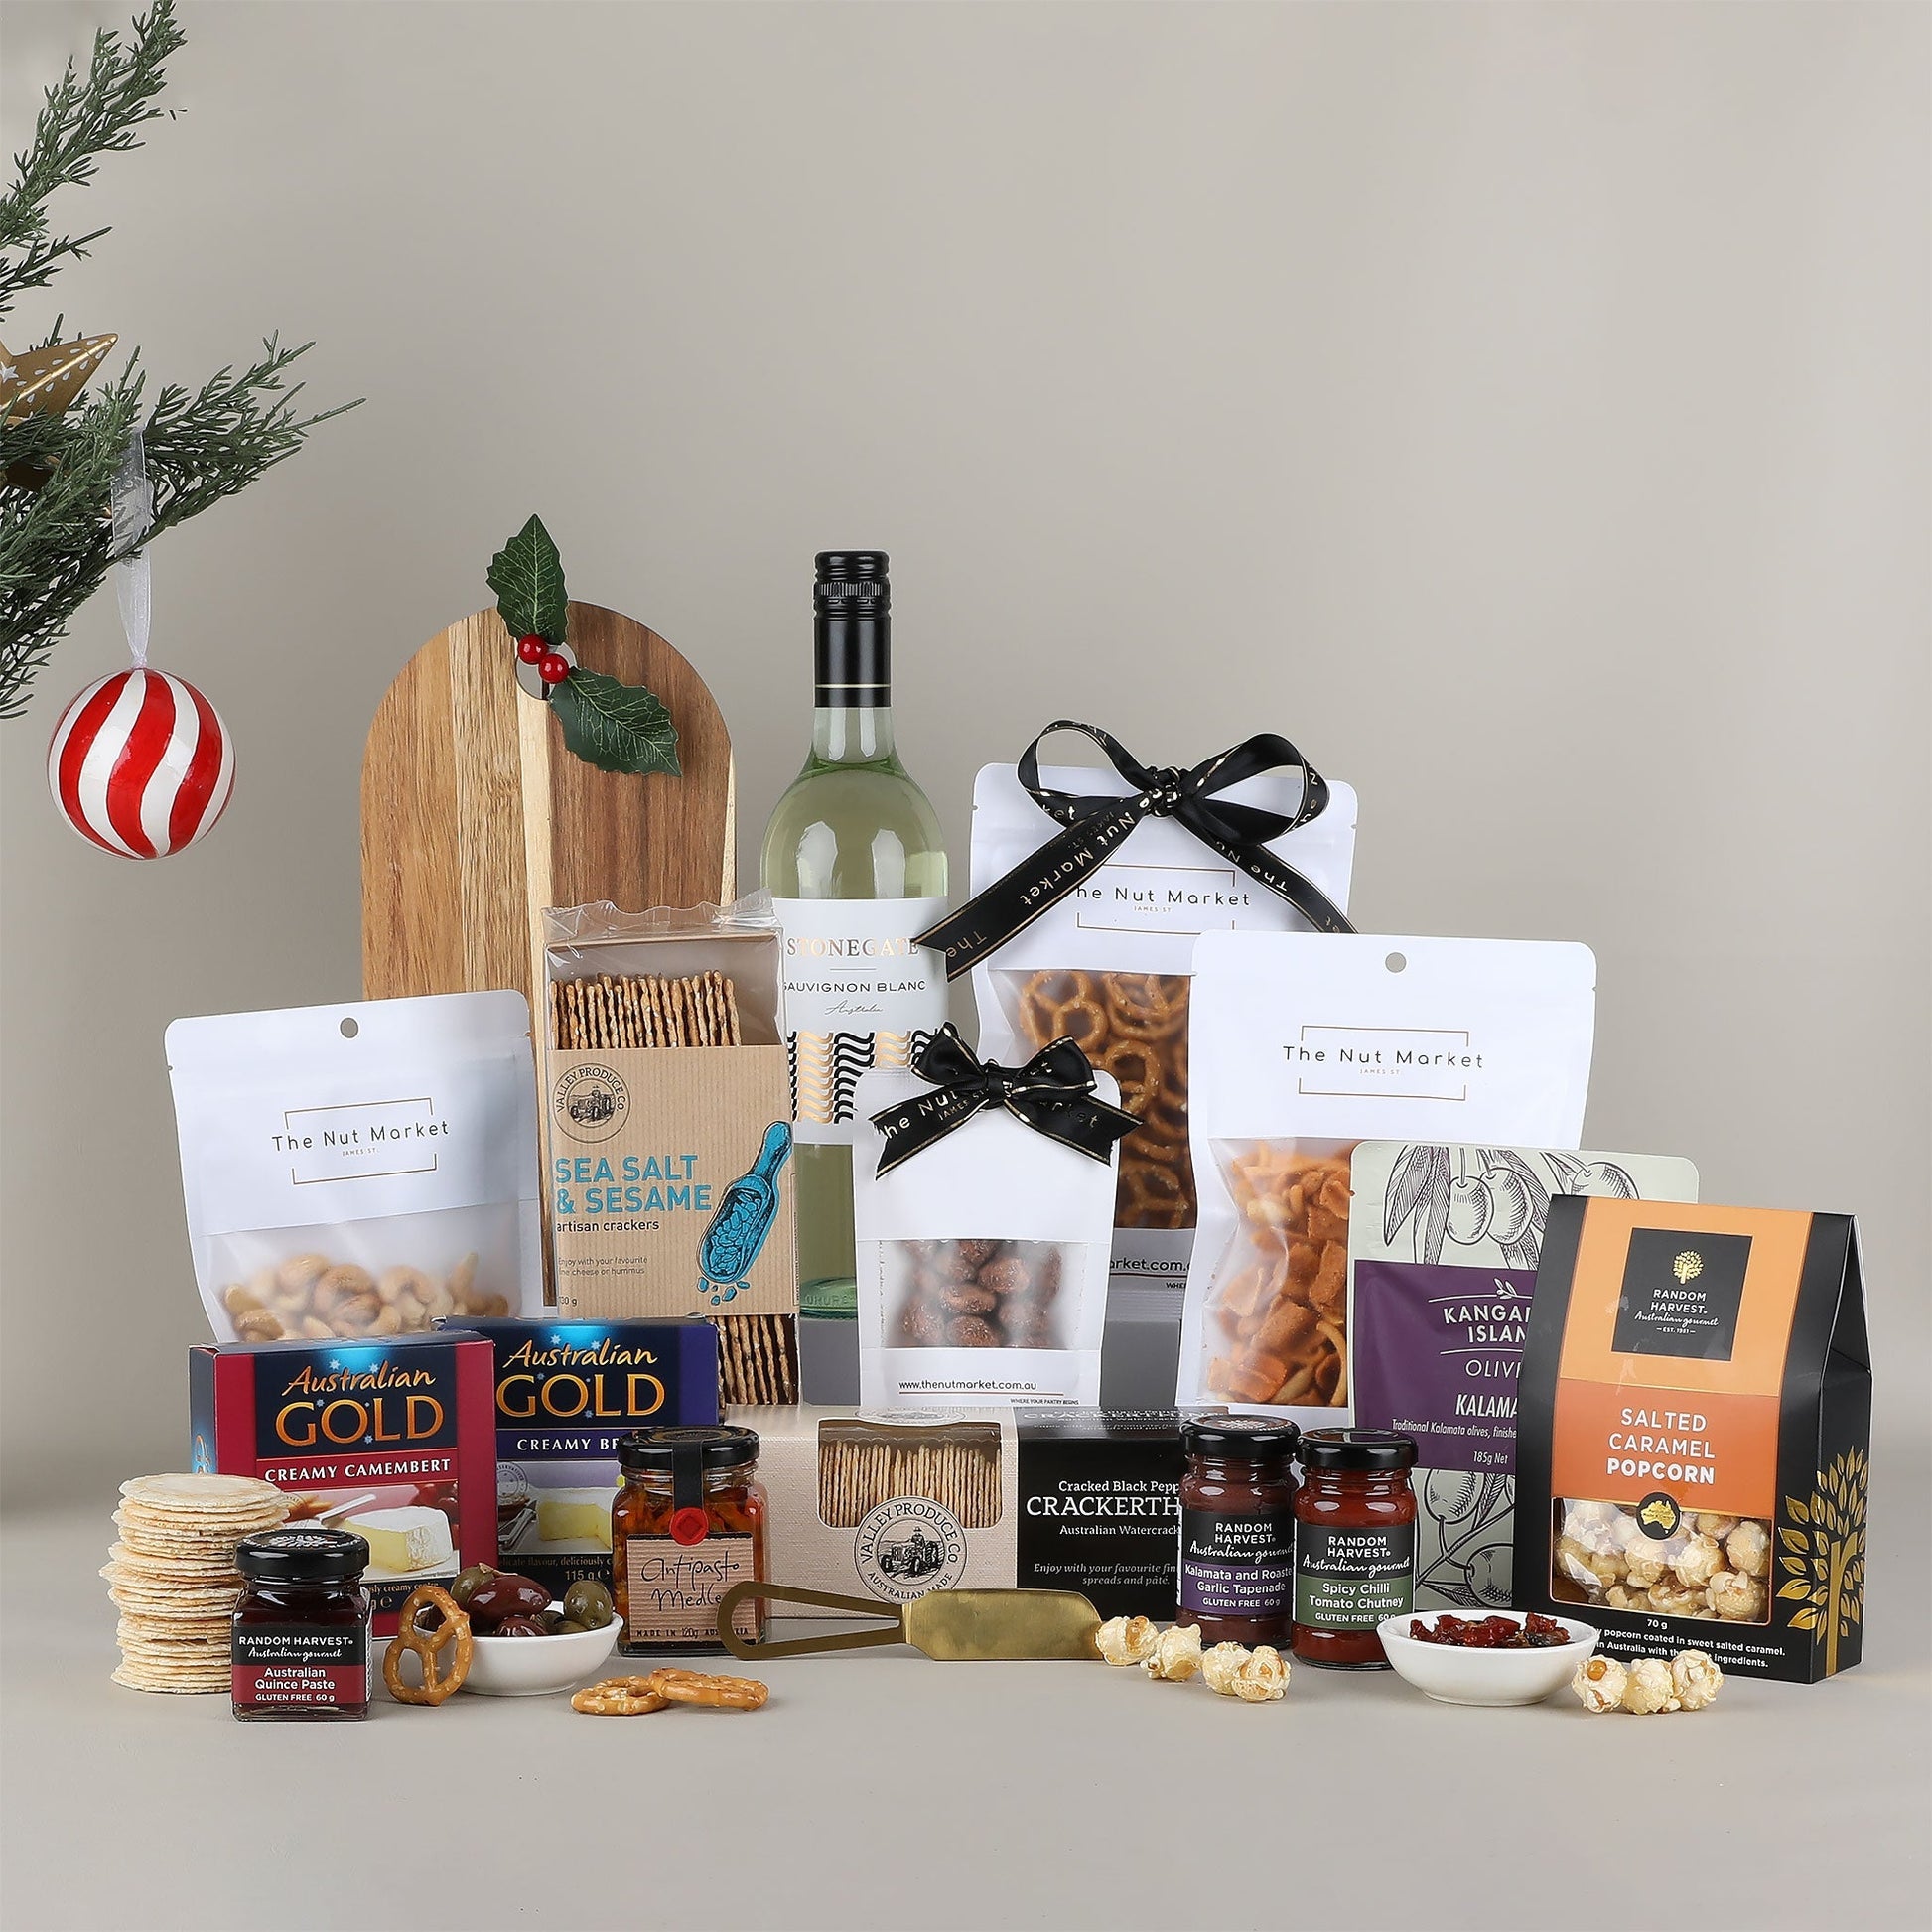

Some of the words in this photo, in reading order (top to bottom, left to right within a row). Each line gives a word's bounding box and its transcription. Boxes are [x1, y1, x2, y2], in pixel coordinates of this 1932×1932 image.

[1096, 811, 1136, 846] Nut
[1020, 847, 1094, 905] Market
[1250, 864, 1288, 892] The
[1076, 887, 1102, 898] he
[1115, 887, 1155, 902] Nut
[1168, 890, 1250, 906] Market
[786, 937, 920, 957] STONEGATE
[946, 931, 988, 958] The
[876, 980, 926, 993] BLANC
[1283, 1045, 1326, 1062] The
[1340, 1048, 1381, 1064] Nut
[1396, 1050, 1483, 1069] Market
[556, 1071, 578, 1113] VALLEY
[578, 1067, 624, 1095] PRODUCE
[271, 1135, 313, 1152] The
[323, 1129, 359, 1147] Nut
[370, 1120, 449, 1142] Market
[554, 1157, 614, 1184] SEA
[621, 1154, 699, 1181] SALT
[556, 1189, 576, 1215] &
[585, 1184, 712, 1214] SESAME
[556, 1220, 599, 1233] artisan
[603, 1219, 660, 1232] crackers
[596, 1258, 613, 1267] your
[614, 1255, 648, 1265] favourite
[1652, 1289, 1707, 1302] RANDOM
[1443, 1304, 1531, 1324] KANGA
[1634, 1311, 1682, 1324] Australian
[501, 1337, 658, 1368] Australian
[281, 1359, 437, 1397] Australian
[898, 1379, 1036, 1391] www.thenutmarket.com.au
[496, 1373, 666, 1418] GOLD
[274, 1395, 444, 1448] GOLD
[1391, 1418, 1429, 1433] Traditional
[1430, 1422, 1465, 1436] Kalamata
[1466, 1424, 1491, 1439] olives,
[1620, 1407, 1708, 1432] SALTED
[516, 1438, 592, 1450] CREAMY
[1608, 1433, 1716, 1459] CARAMEL
[1472, 1450, 1492, 1465] 185g
[1493, 1452, 1508, 1464] Net
[264, 1464, 338, 1482] CREAMY
[345, 1458, 451, 1478] CAMEMBERT
[1606, 1457, 1715, 1485] POPCORN
[1058, 1480, 1109, 1492] Cracked
[1112, 1480, 1149, 1492] Black
[1150, 1481, 1179, 1495] Pepp
[860, 1507, 894, 1565] VALLEY
[894, 1502, 958, 1542] PRODUCE
[1059, 1525, 1117, 1535] Australian
[1215, 1522, 1272, 1533] RANDOM
[1189, 1540, 1255, 1558] Australian
[1328, 1536, 1387, 1547] RANDOM
[560, 1555, 604, 1567] deliciously
[1034, 1563, 1062, 1574] Enjoy
[1064, 1563, 1086, 1573] with
[1088, 1565, 1111, 1574] your
[1113, 1563, 1161, 1574] favourite
[1302, 1554, 1368, 1572] Australian
[1368, 1556, 1410, 1579] gourmet
[565, 1570, 584, 1581] 115
[641, 1550, 740, 1591] Antipasto
[1184, 1563, 1232, 1580] Kalamata
[1235, 1569, 1259, 1581] and
[383, 1584, 411, 1593] creamy
[867, 1572, 925, 1600] AUSTRALIAN
[1082, 1575, 1121, 1586] spreads
[1123, 1575, 1143, 1585] and
[1145, 1575, 1170, 1586] pâté.
[1197, 1581, 1230, 1594] Garlic
[1232, 1582, 1286, 1596] Tapenade
[1322, 1583, 1357, 1596] Spicy
[1360, 1583, 1390, 1594] Chilli
[1202, 1597, 1236, 1607] GLUTEN
[1309, 1594, 1354, 1609] Tomato
[1357, 1596, 1404, 1609] Chutney
[1314, 1612, 1349, 1622] GLUTEN
[1647, 1618, 1659, 1628] 70
[1660, 1621, 1668, 1630] g
[238, 1636, 291, 1646] RANDOM
[1604, 1628, 1641, 1640] popcorn
[1643, 1632, 1674, 1644] coated
[1676, 1636, 1686, 1645] in
[1687, 1638, 1714, 1649] sweet
[1716, 1640, 1744, 1652] salted
[1745, 1645, 1786, 1656] caramel.
[248, 1646, 303, 1659] Australian
[302, 1648, 342, 1662] gourmet
[1607, 1641, 1646, 1654] Australia
[1648, 1645, 1668, 1656] with
[1669, 1647, 1680, 1657] th
[1714, 1653, 1769, 1668] ingredients.
[264, 1667, 326, 1678] Australian
[254, 1679, 298, 1690] Quince
[301, 1679, 336, 1690] Paste
